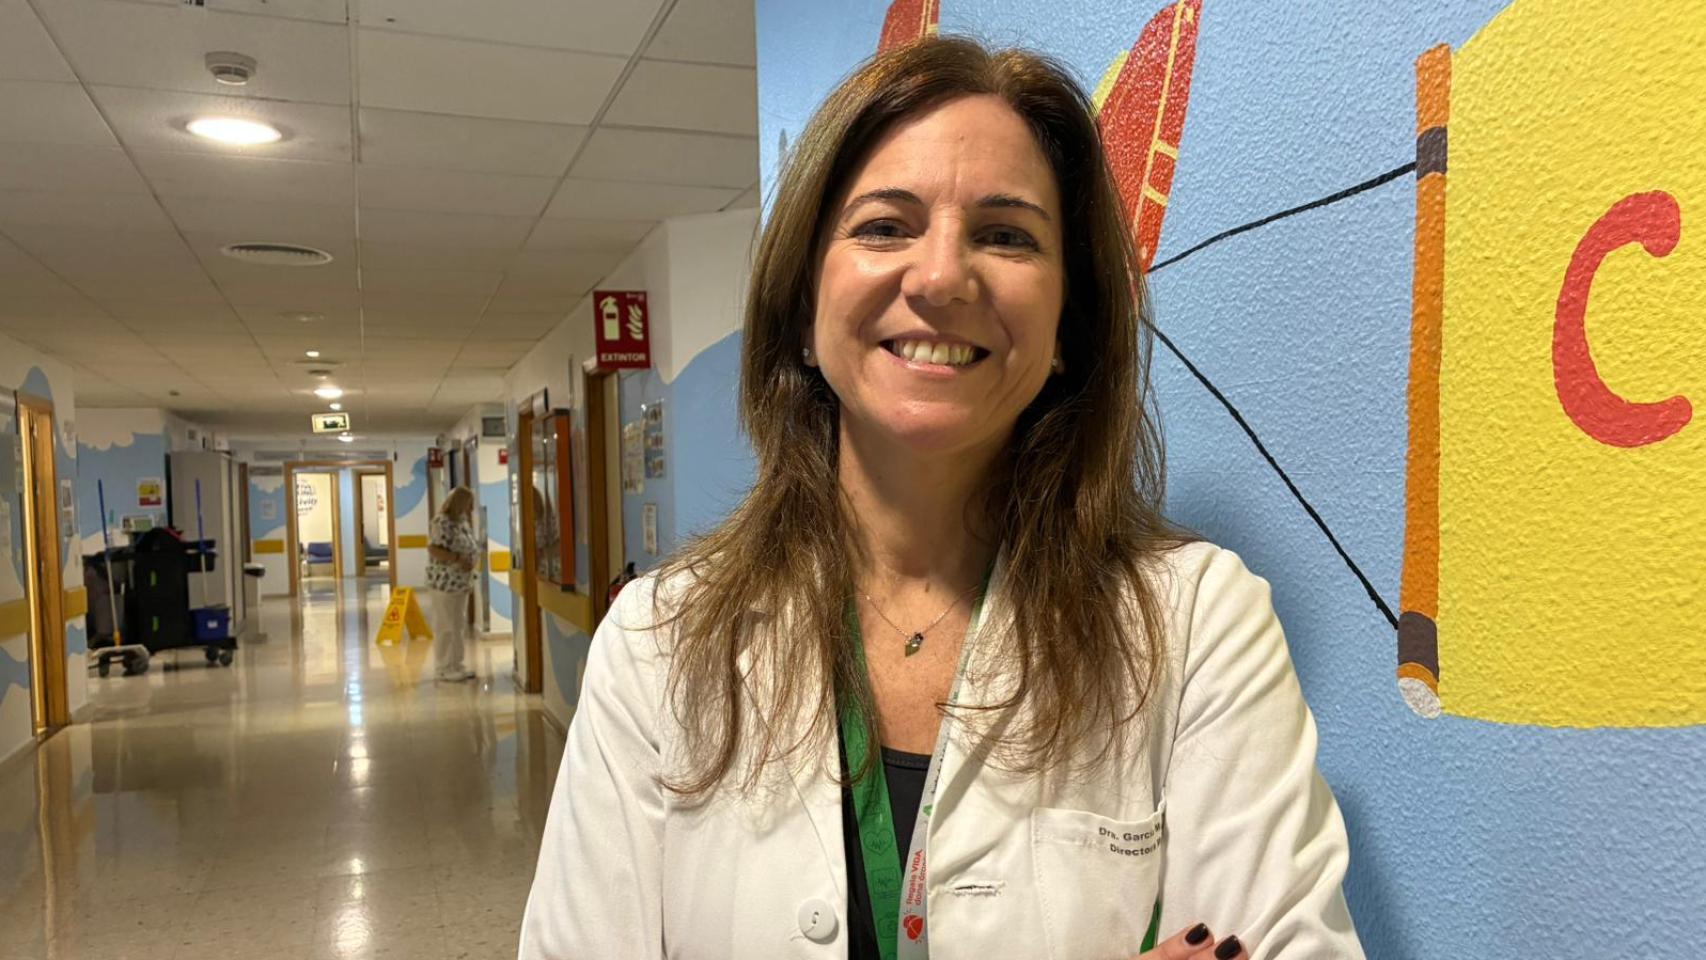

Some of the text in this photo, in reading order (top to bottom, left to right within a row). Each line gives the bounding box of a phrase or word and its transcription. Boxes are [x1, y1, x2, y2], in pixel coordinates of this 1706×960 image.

[1552, 190, 1692, 447] C
[601, 352, 646, 362] EXTINTOR
[912, 849, 923, 872] VIDA
[914, 883, 923, 905] dona
